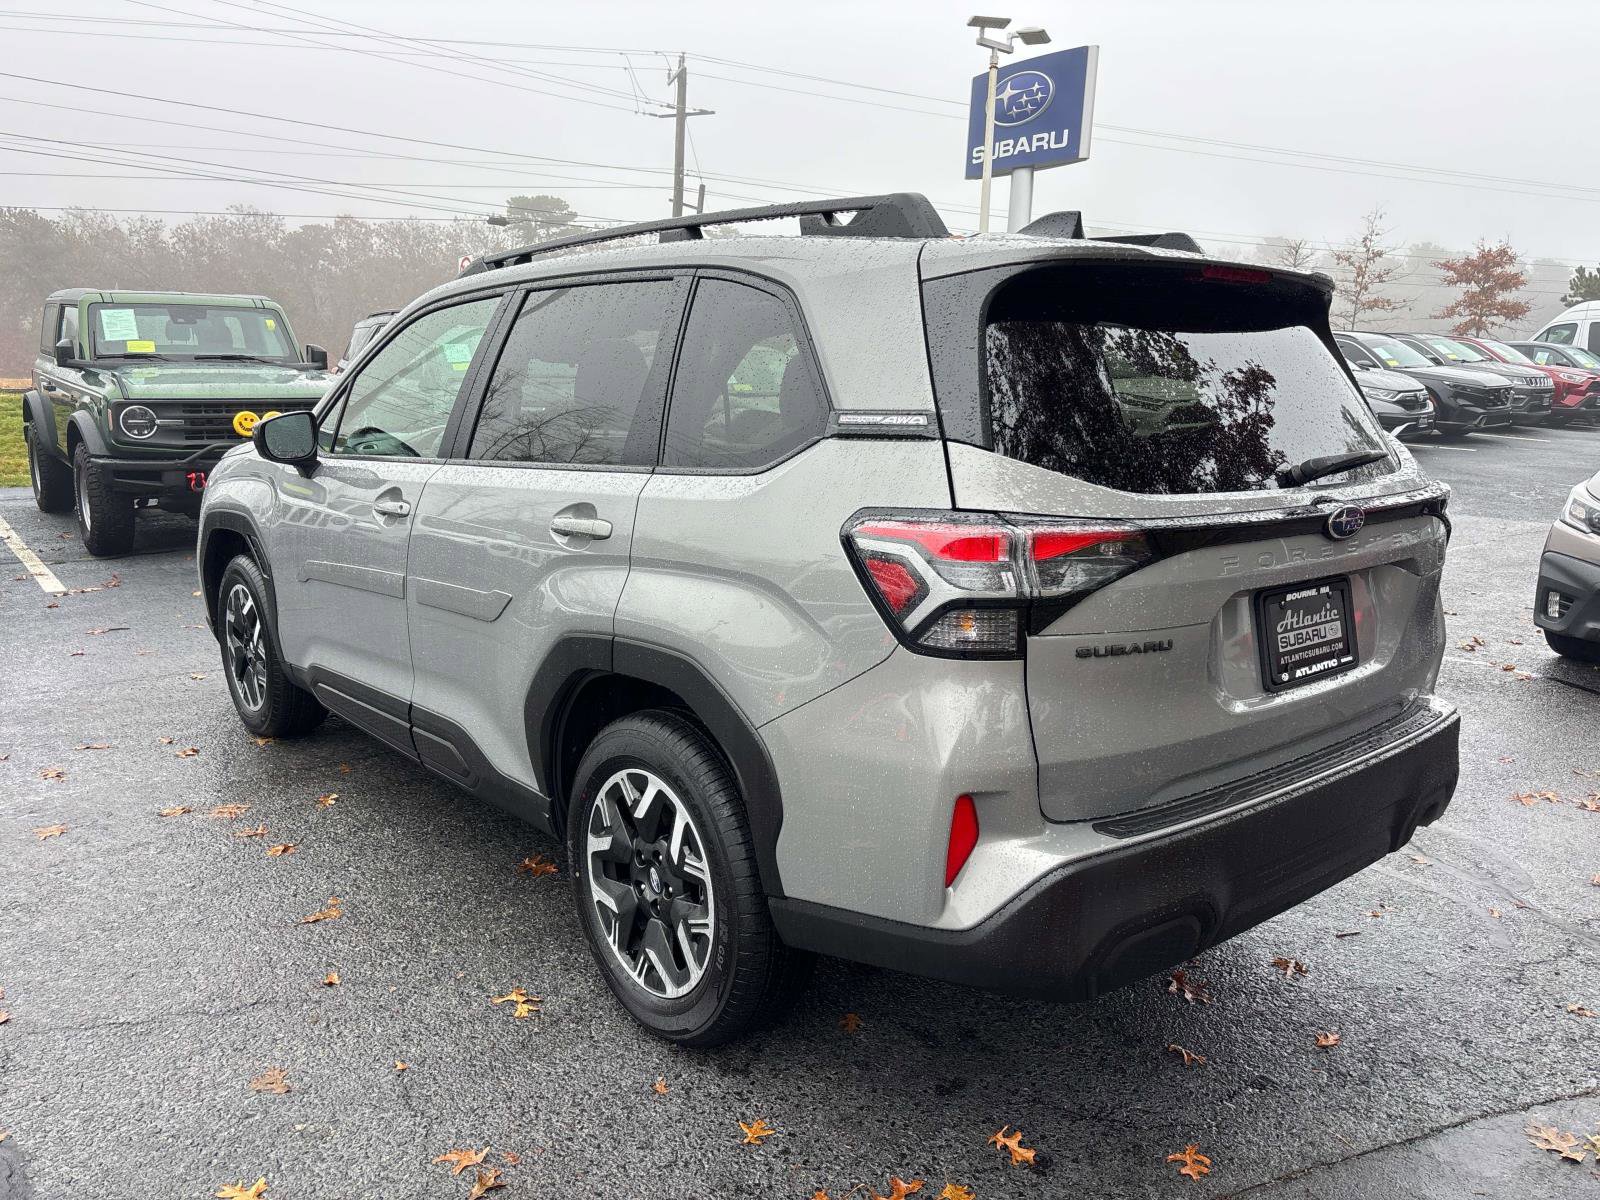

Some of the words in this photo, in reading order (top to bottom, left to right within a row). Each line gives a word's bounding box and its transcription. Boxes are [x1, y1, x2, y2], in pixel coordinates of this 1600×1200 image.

[1276, 602, 1339, 633] Atlantic
[1075, 638, 1173, 658] SUBARU
[1279, 625, 1327, 650] SUBARU
[1280, 641, 1344, 665] ATLANTICSUBARU.COM
[1295, 658, 1338, 678] ATLANTIC
